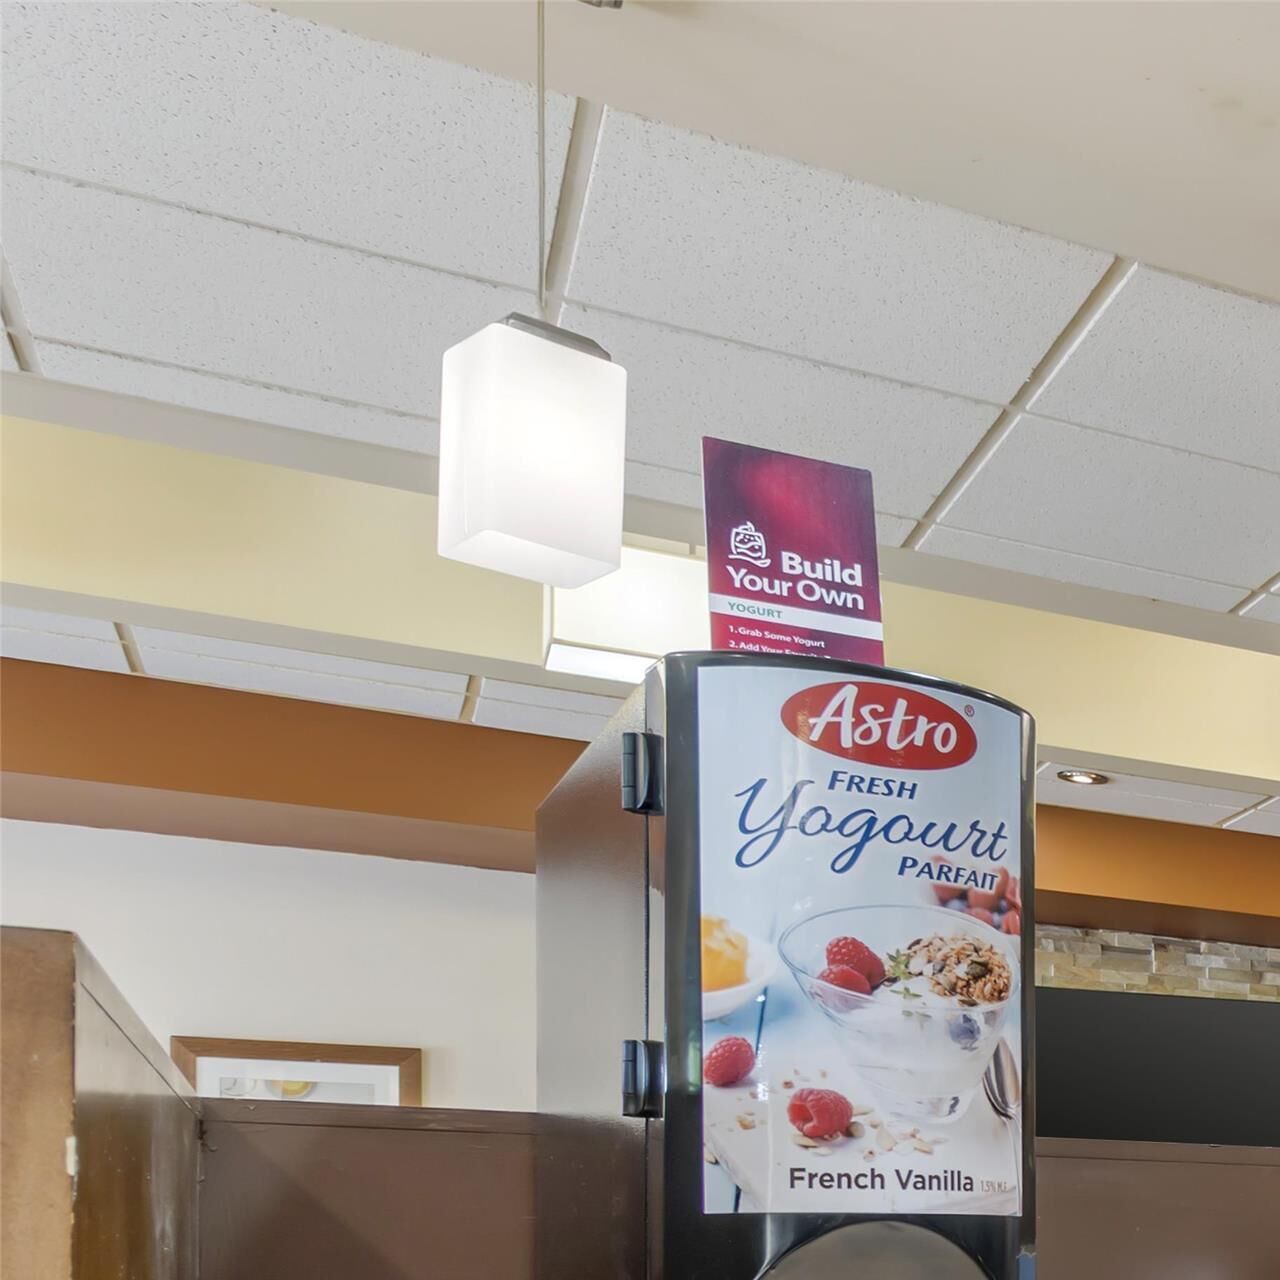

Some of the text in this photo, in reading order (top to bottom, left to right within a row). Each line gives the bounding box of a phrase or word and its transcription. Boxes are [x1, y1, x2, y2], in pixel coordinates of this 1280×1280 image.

[781, 551, 863, 587] Build
[726, 565, 865, 610] Your Own
[728, 601, 783, 619] YOGURT
[738, 627, 763, 638] Grab
[764, 631, 792, 643] Some
[792, 636, 826, 649] Yogurt
[739, 641, 760, 652] Add
[808, 683, 958, 754] Astro
[827, 770, 919, 800] FRESH
[734, 778, 1008, 875] Yogourt
[897, 856, 999, 891] PARFAIT
[789, 1167, 886, 1190] French
[894, 1169, 975, 1192] Vanilla
